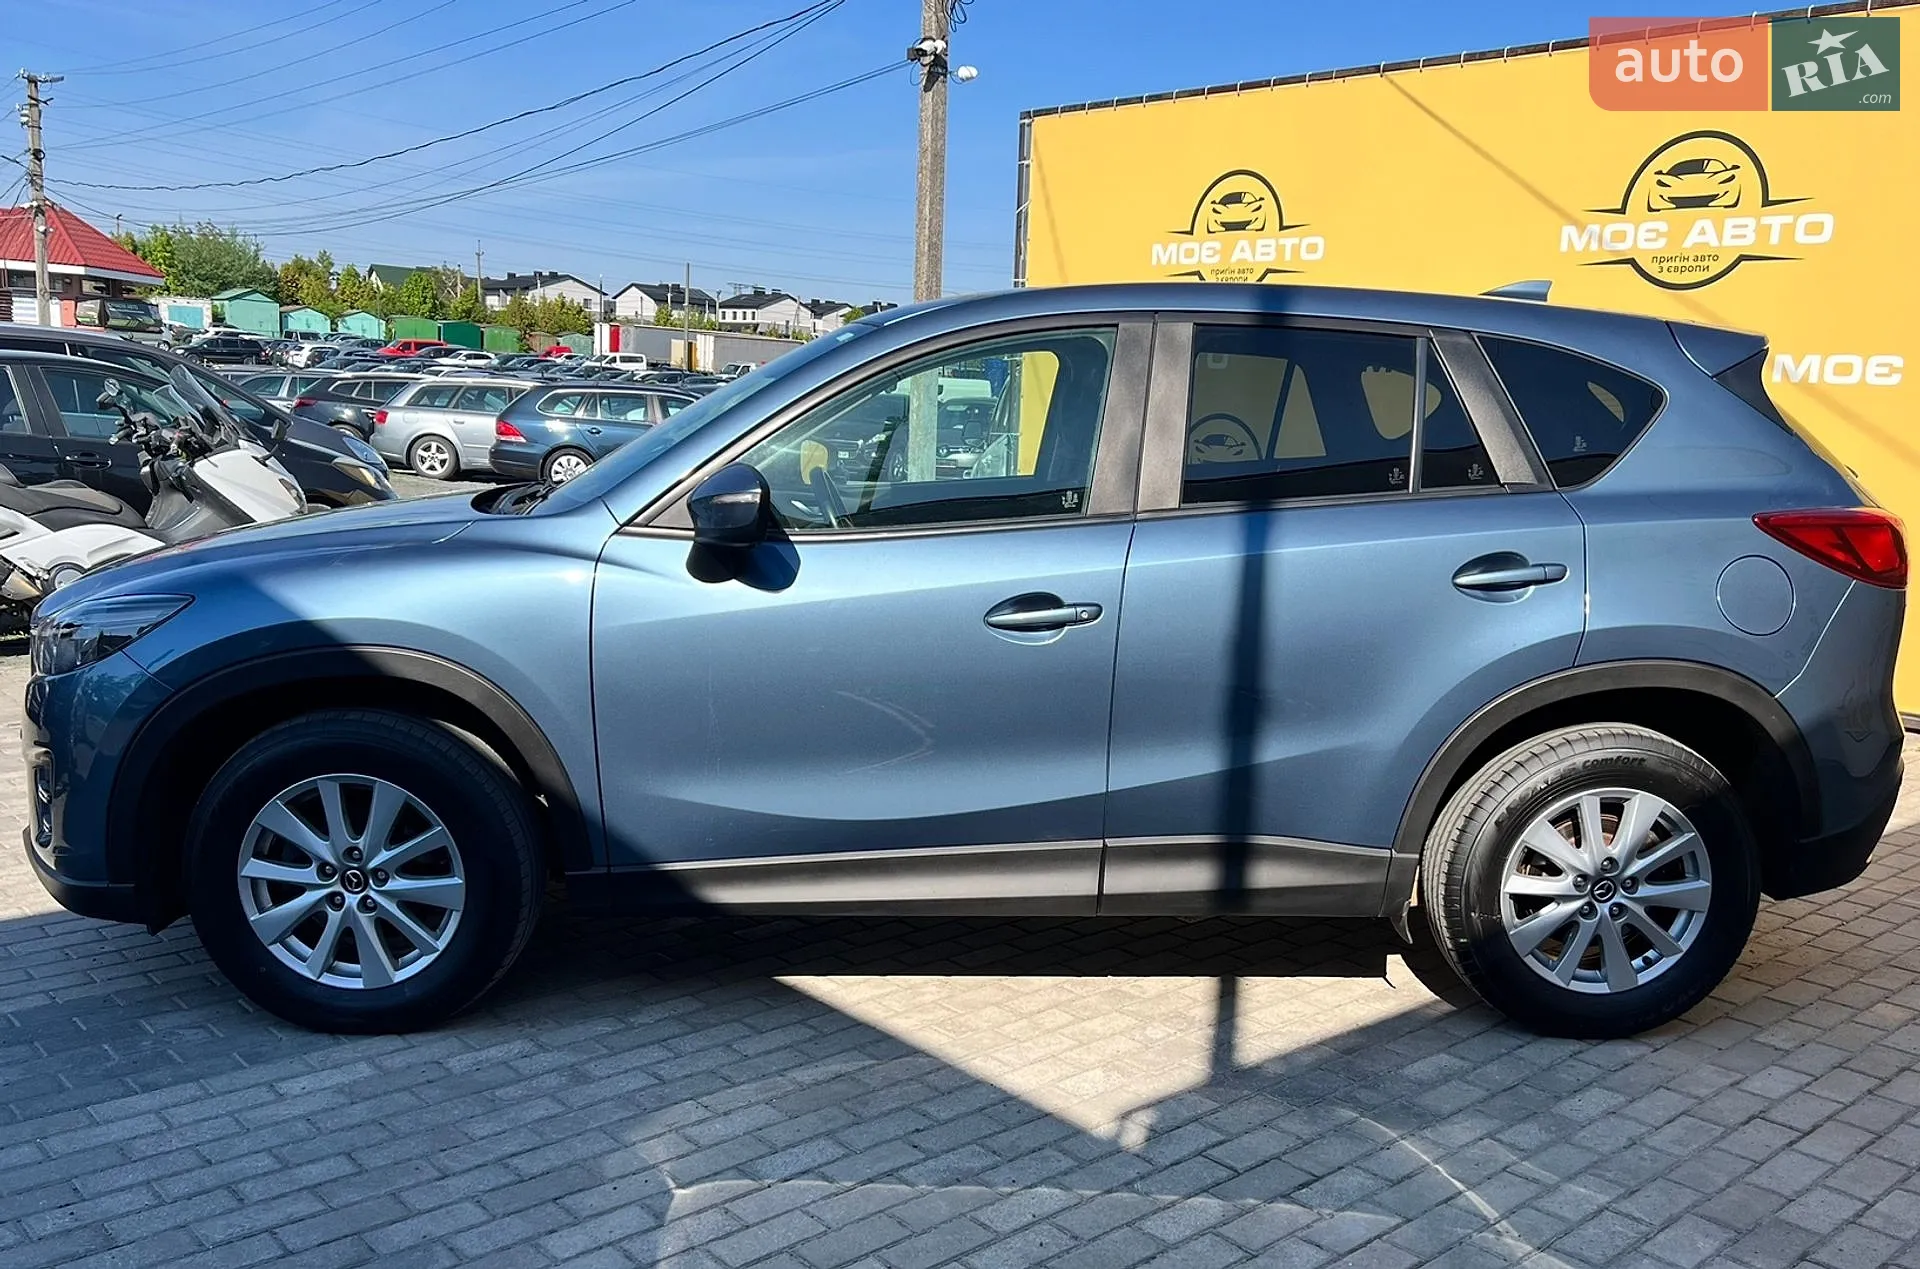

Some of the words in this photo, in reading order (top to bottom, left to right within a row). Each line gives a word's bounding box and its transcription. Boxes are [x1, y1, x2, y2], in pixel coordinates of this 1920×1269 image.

[1559, 220, 1668, 252] МОЄ
[1681, 212, 1835, 248] АВТО
[1152, 240, 1222, 265] МОЄ
[1230, 235, 1325, 263] АВТО
[1651, 252, 1690, 265] пригін
[1692, 253, 1720, 262] авто
[1666, 264, 1710, 275] європи
[1771, 354, 1904, 386] МОЄ
